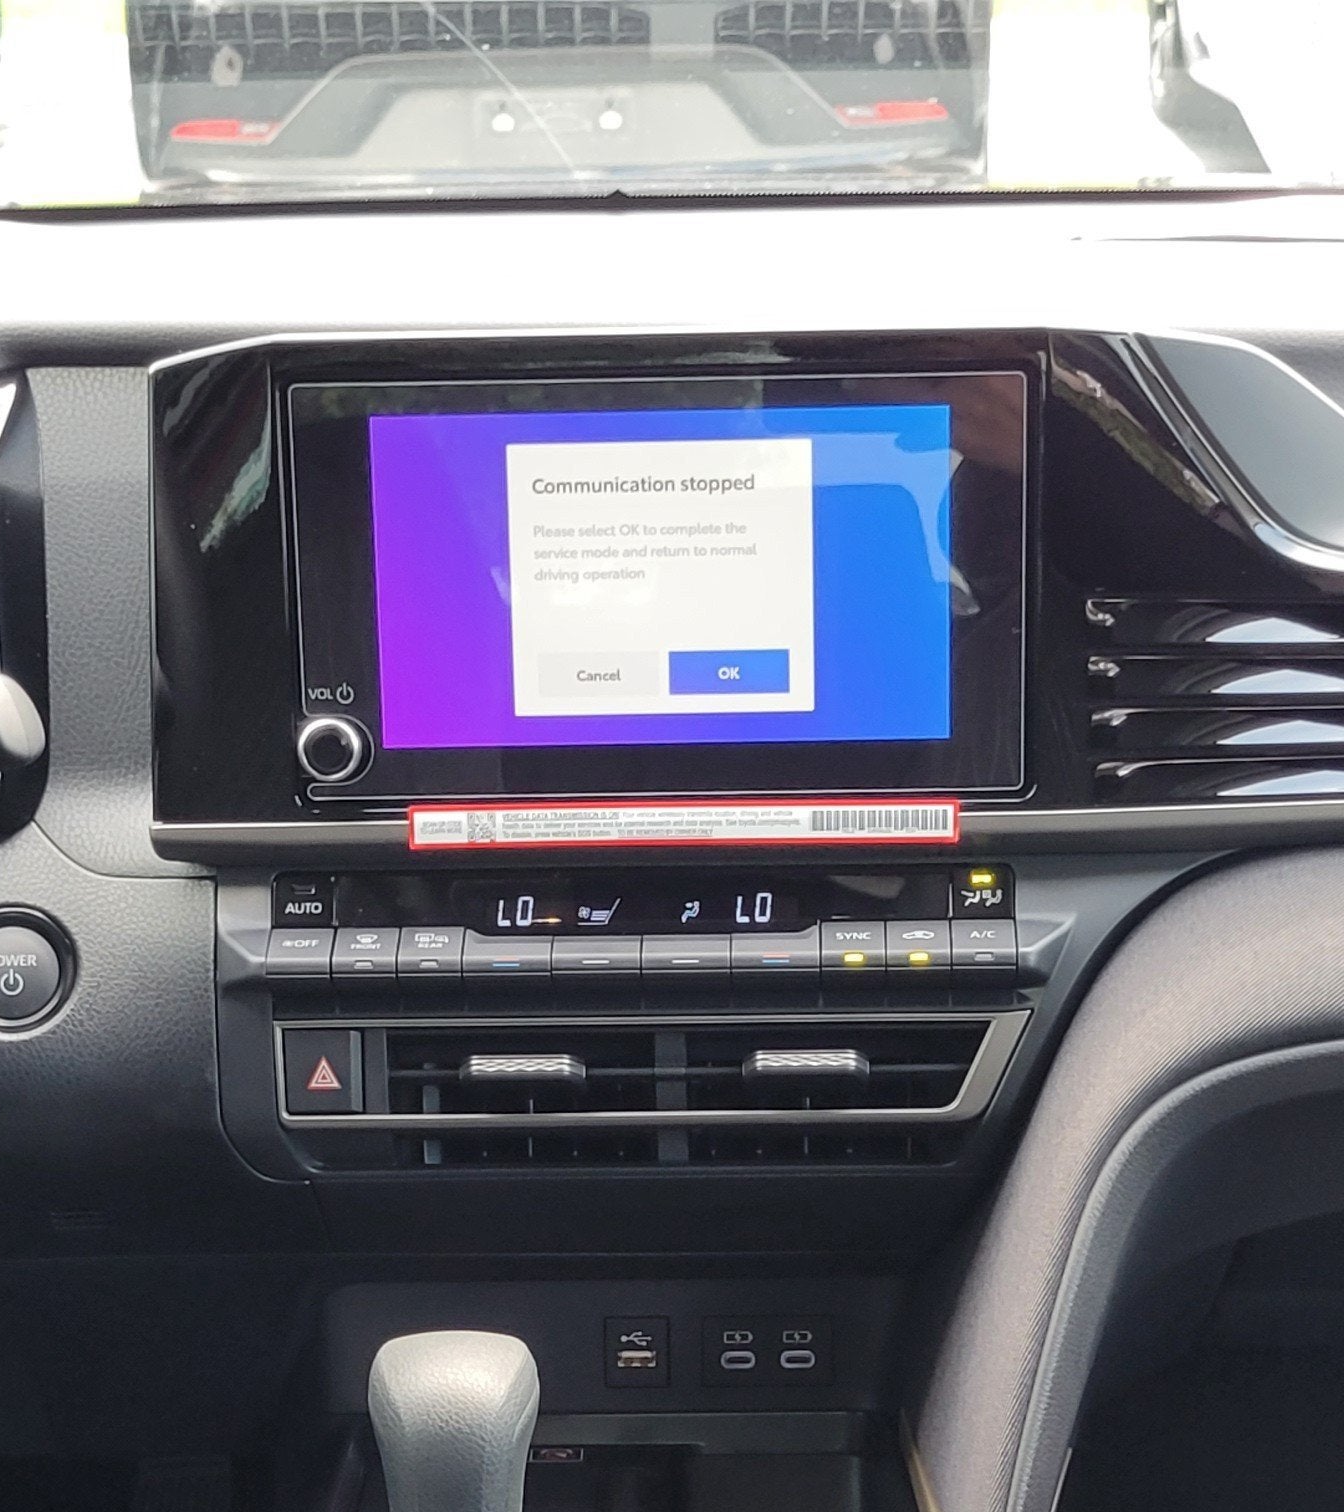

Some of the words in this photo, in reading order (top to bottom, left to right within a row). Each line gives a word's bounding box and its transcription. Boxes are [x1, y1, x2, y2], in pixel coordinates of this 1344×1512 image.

[532, 476, 675, 494] Communication
[680, 473, 755, 495] stopped
[533, 524, 575, 538] Please
[578, 524, 616, 538] select
[619, 523, 640, 536] OK
[643, 524, 657, 536] to
[659, 522, 722, 538] complete
[725, 521, 747, 535] the
[534, 547, 578, 560] service
[581, 546, 619, 559] mode
[622, 545, 648, 558] and
[651, 545, 690, 558] return
[693, 545, 707, 557] to
[710, 543, 758, 557] normal
[534, 568, 580, 584] driving
[576, 668, 622, 683] Cancel
[718, 665, 741, 680] OK
[307, 688, 334, 701] VOL
[284, 901, 323, 915] AUTO
[835, 931, 872, 940] SYNC
[969, 930, 997, 939] A/C
[295, 939, 320, 948] OFF
